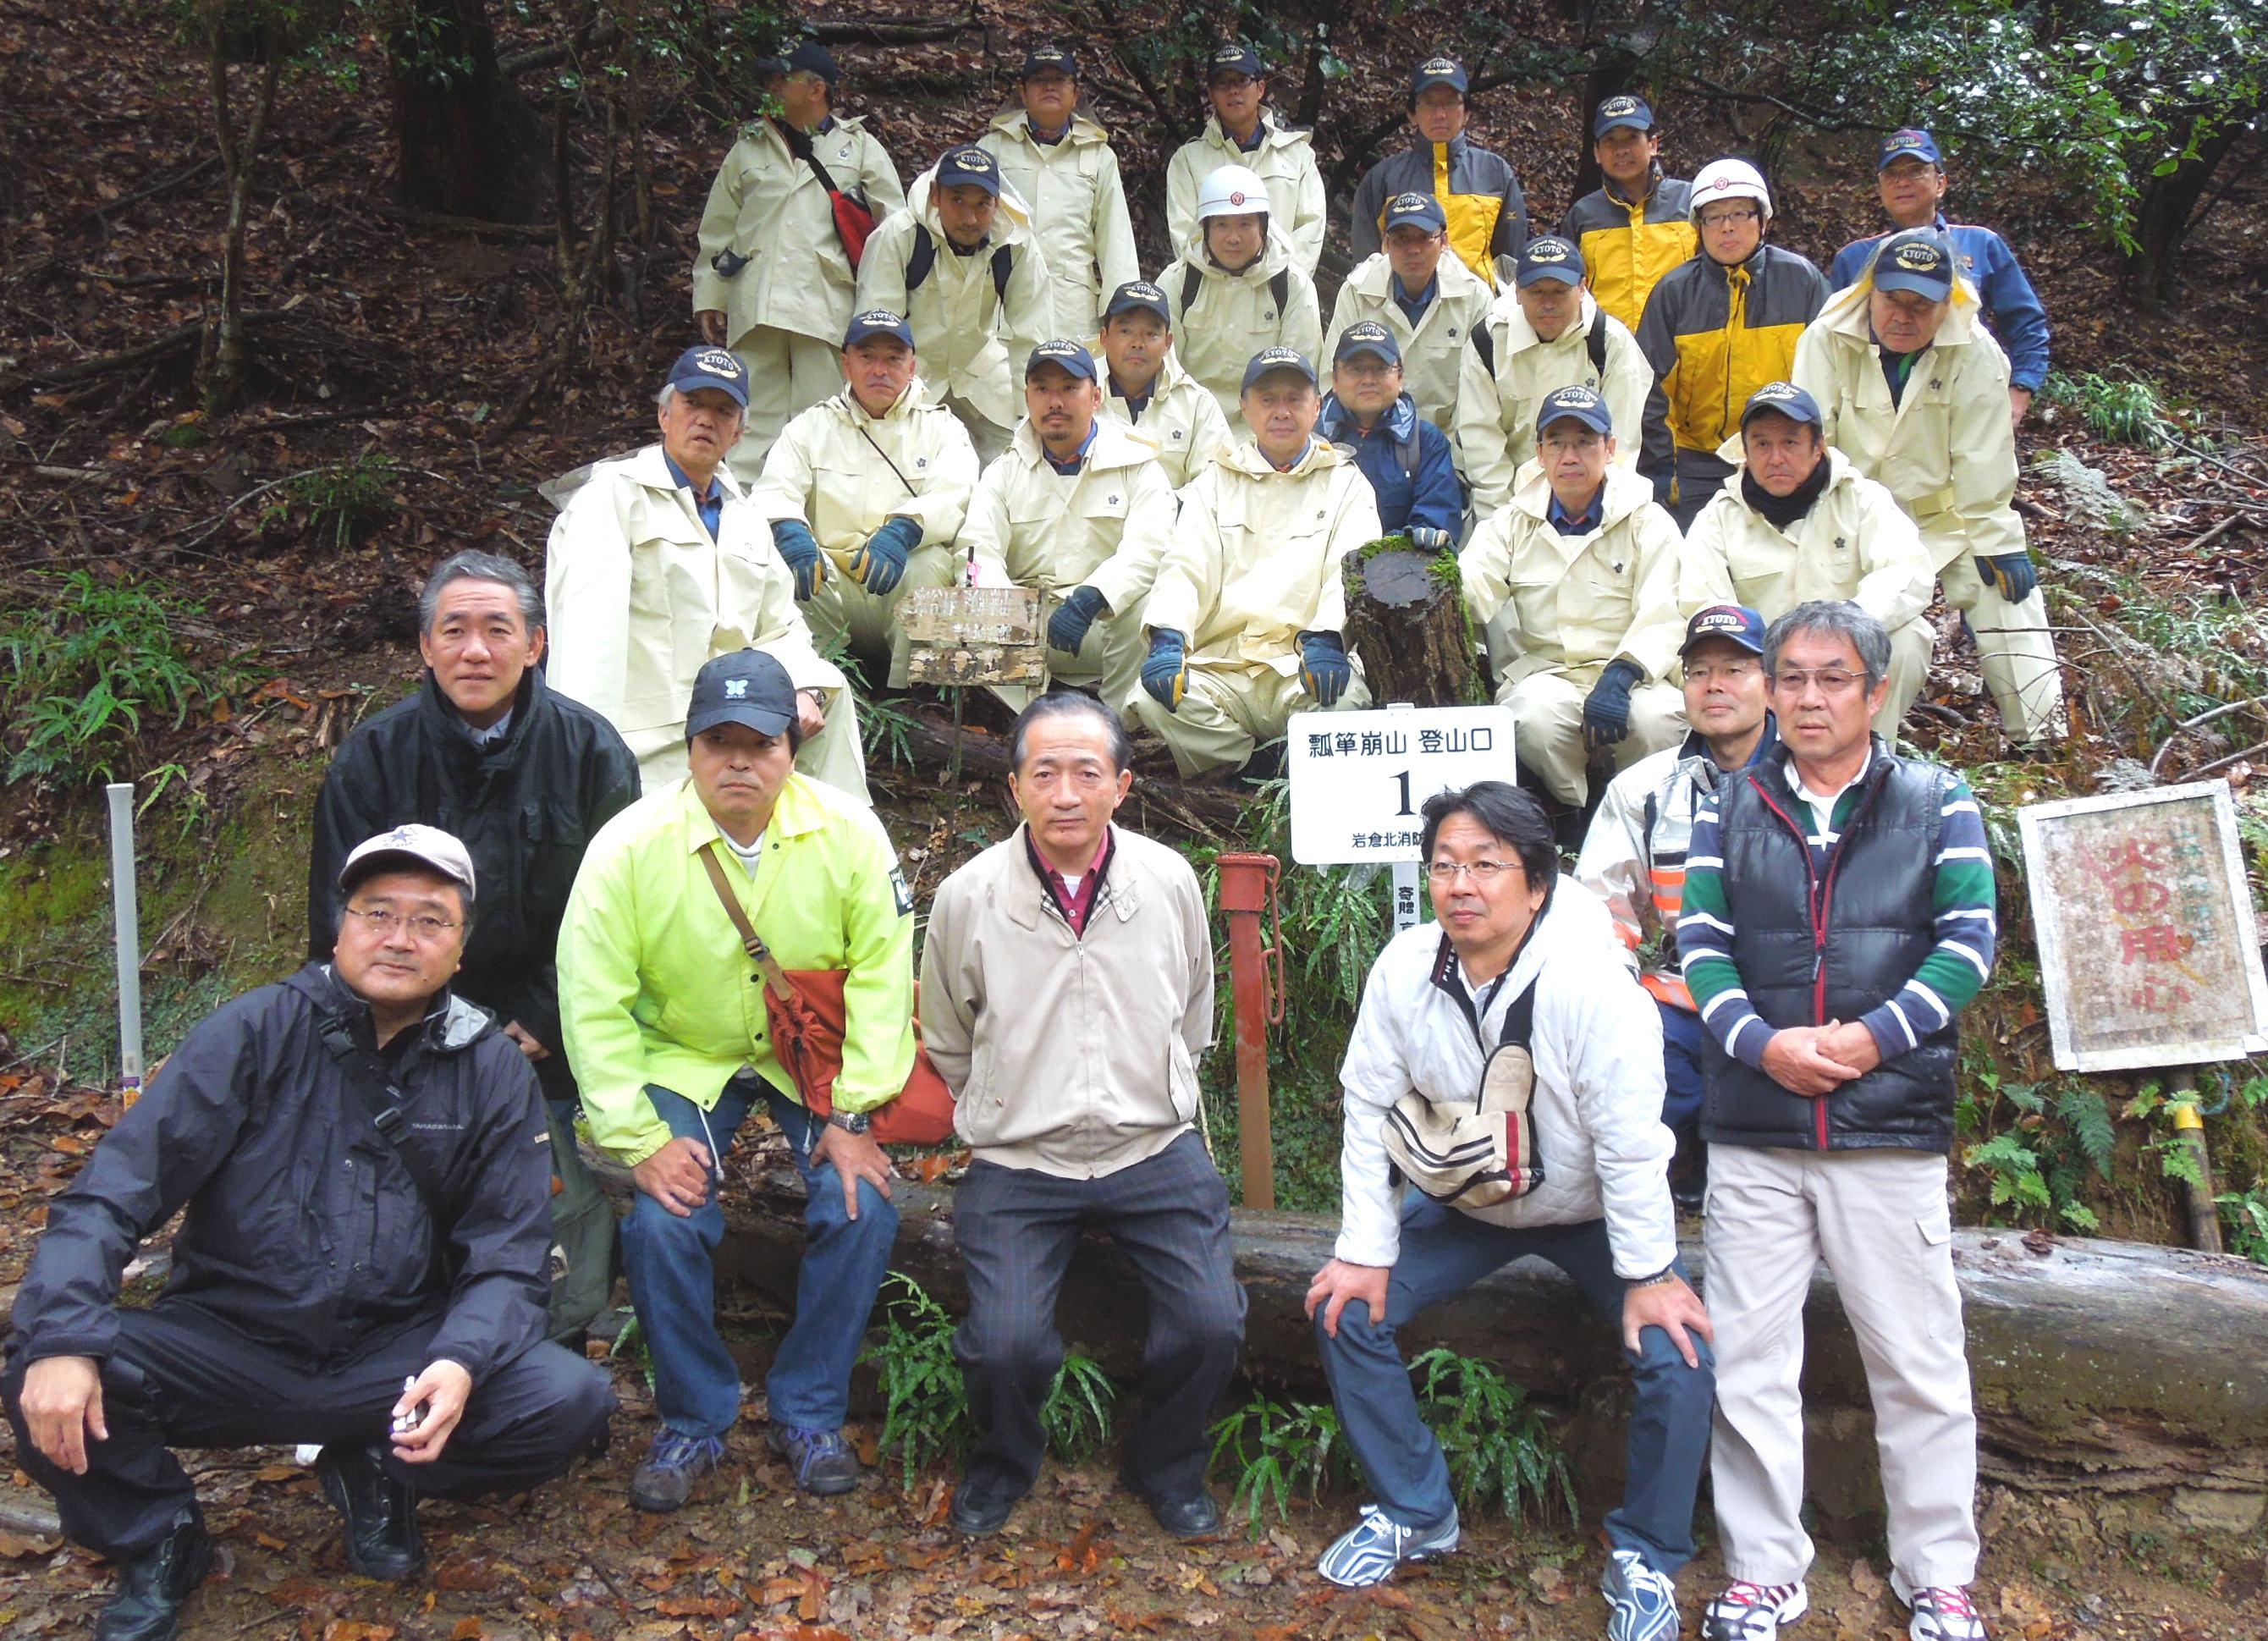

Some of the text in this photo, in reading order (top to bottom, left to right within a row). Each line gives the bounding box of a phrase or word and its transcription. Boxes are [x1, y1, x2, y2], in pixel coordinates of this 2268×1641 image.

[961, 155, 986, 165] KYOTO
[1396, 197, 1421, 207] KYOTO
[1534, 245, 1562, 255] KYOTO
[1902, 249, 1934, 262] KYOTO
[1266, 349, 1294, 359] KYOTO
[703, 355, 734, 372] KYOTO
[1561, 391, 1590, 402] KYOTO
[1702, 614, 1737, 626] KYOTO
[1308, 727, 1493, 759] 瓢箪崩山 登山口
[1389, 769, 1417, 817] 1
[1398, 886, 1415, 915] 寄贈
[2107, 838, 2194, 1014] 火の用心
